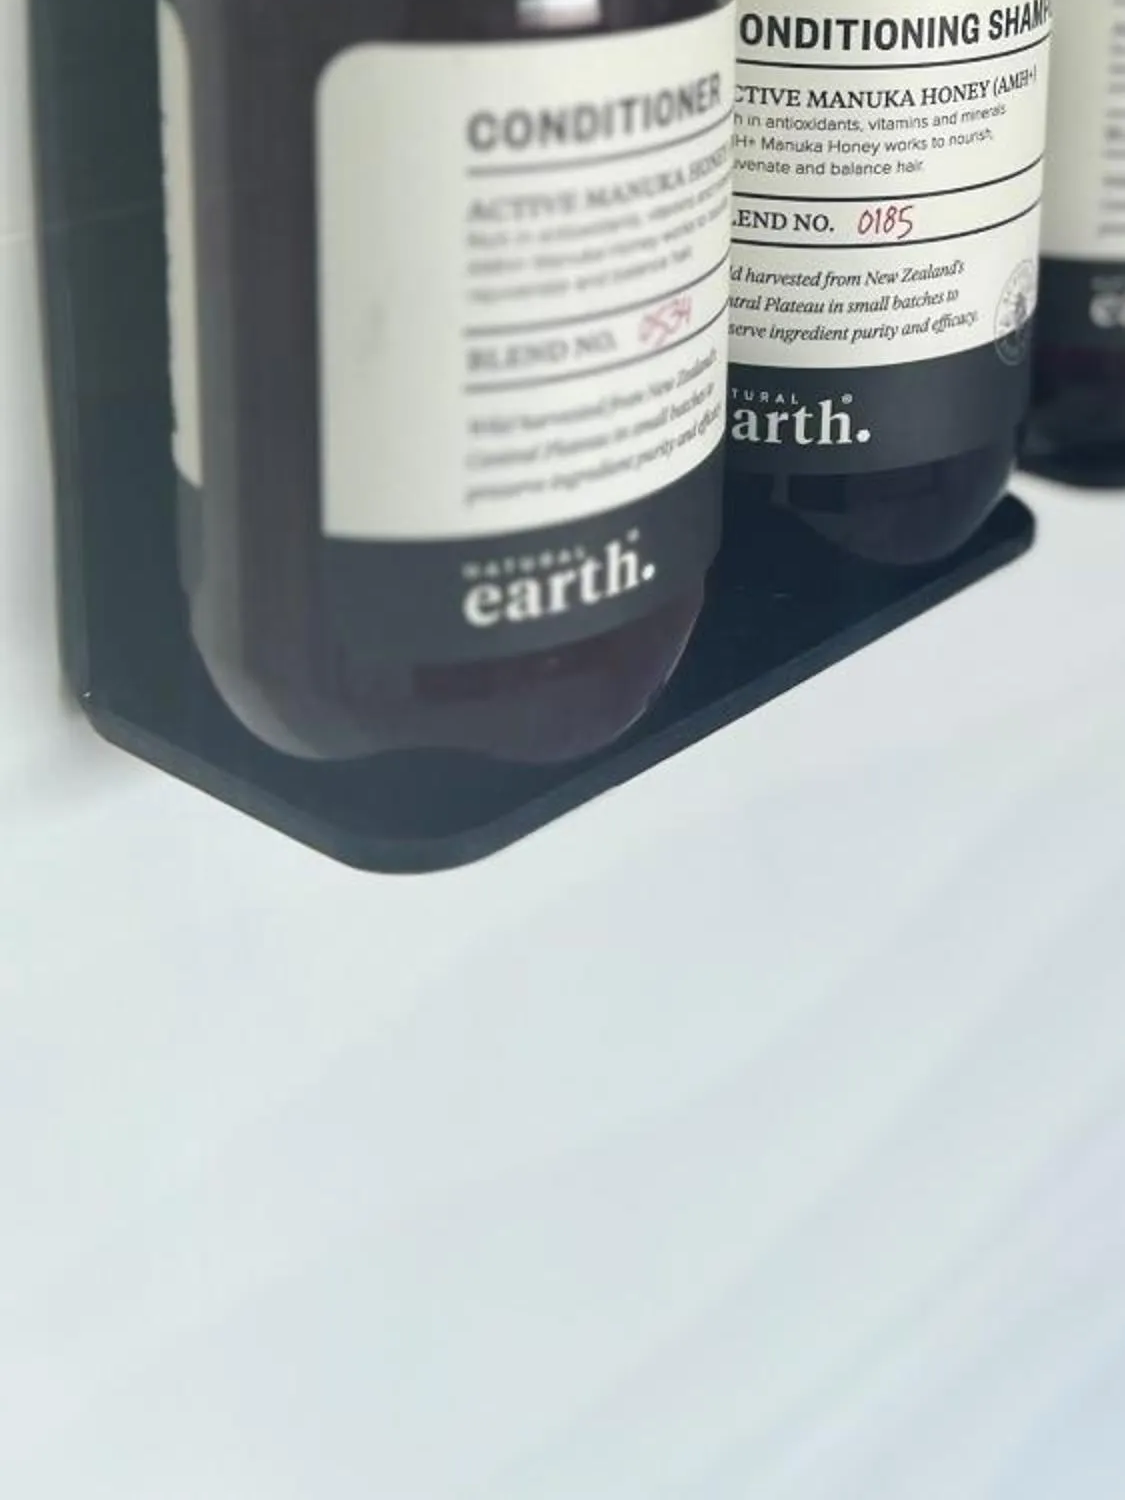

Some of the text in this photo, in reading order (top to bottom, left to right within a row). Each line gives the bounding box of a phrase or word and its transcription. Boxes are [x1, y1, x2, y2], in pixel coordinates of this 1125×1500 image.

[738, 13, 979, 51] ONDITIONING
[736, 84, 800, 107] CTIVE
[806, 88, 915, 109] MANUKA
[921, 79, 990, 106] HONEY
[467, 71, 720, 154] CONDITIONER
[765, 117, 863, 132] antioxidants,
[868, 115, 929, 131] vitamins
[932, 111, 957, 127] and
[961, 103, 1007, 123] minerals
[761, 136, 823, 153] Manuka
[827, 140, 880, 156] Honey
[885, 137, 927, 152] works
[931, 135, 945, 148] to
[734, 159, 791, 175] venate
[795, 161, 825, 175] and
[830, 161, 892, 176] balance
[732, 204, 914, 239] END NO. 0185
[745, 267, 822, 287] harvested
[820, 271, 861, 290] from
[864, 270, 899, 286] New
[729, 288, 959, 314] ntral Plateau in small batches to
[728, 323, 767, 338] serve
[769, 324, 849, 345] ingredient
[850, 322, 899, 344] purity
[901, 317, 930, 336] and
[731, 388, 799, 405] TURAL
[731, 399, 871, 445] arth.
[462, 539, 656, 628] earth.
